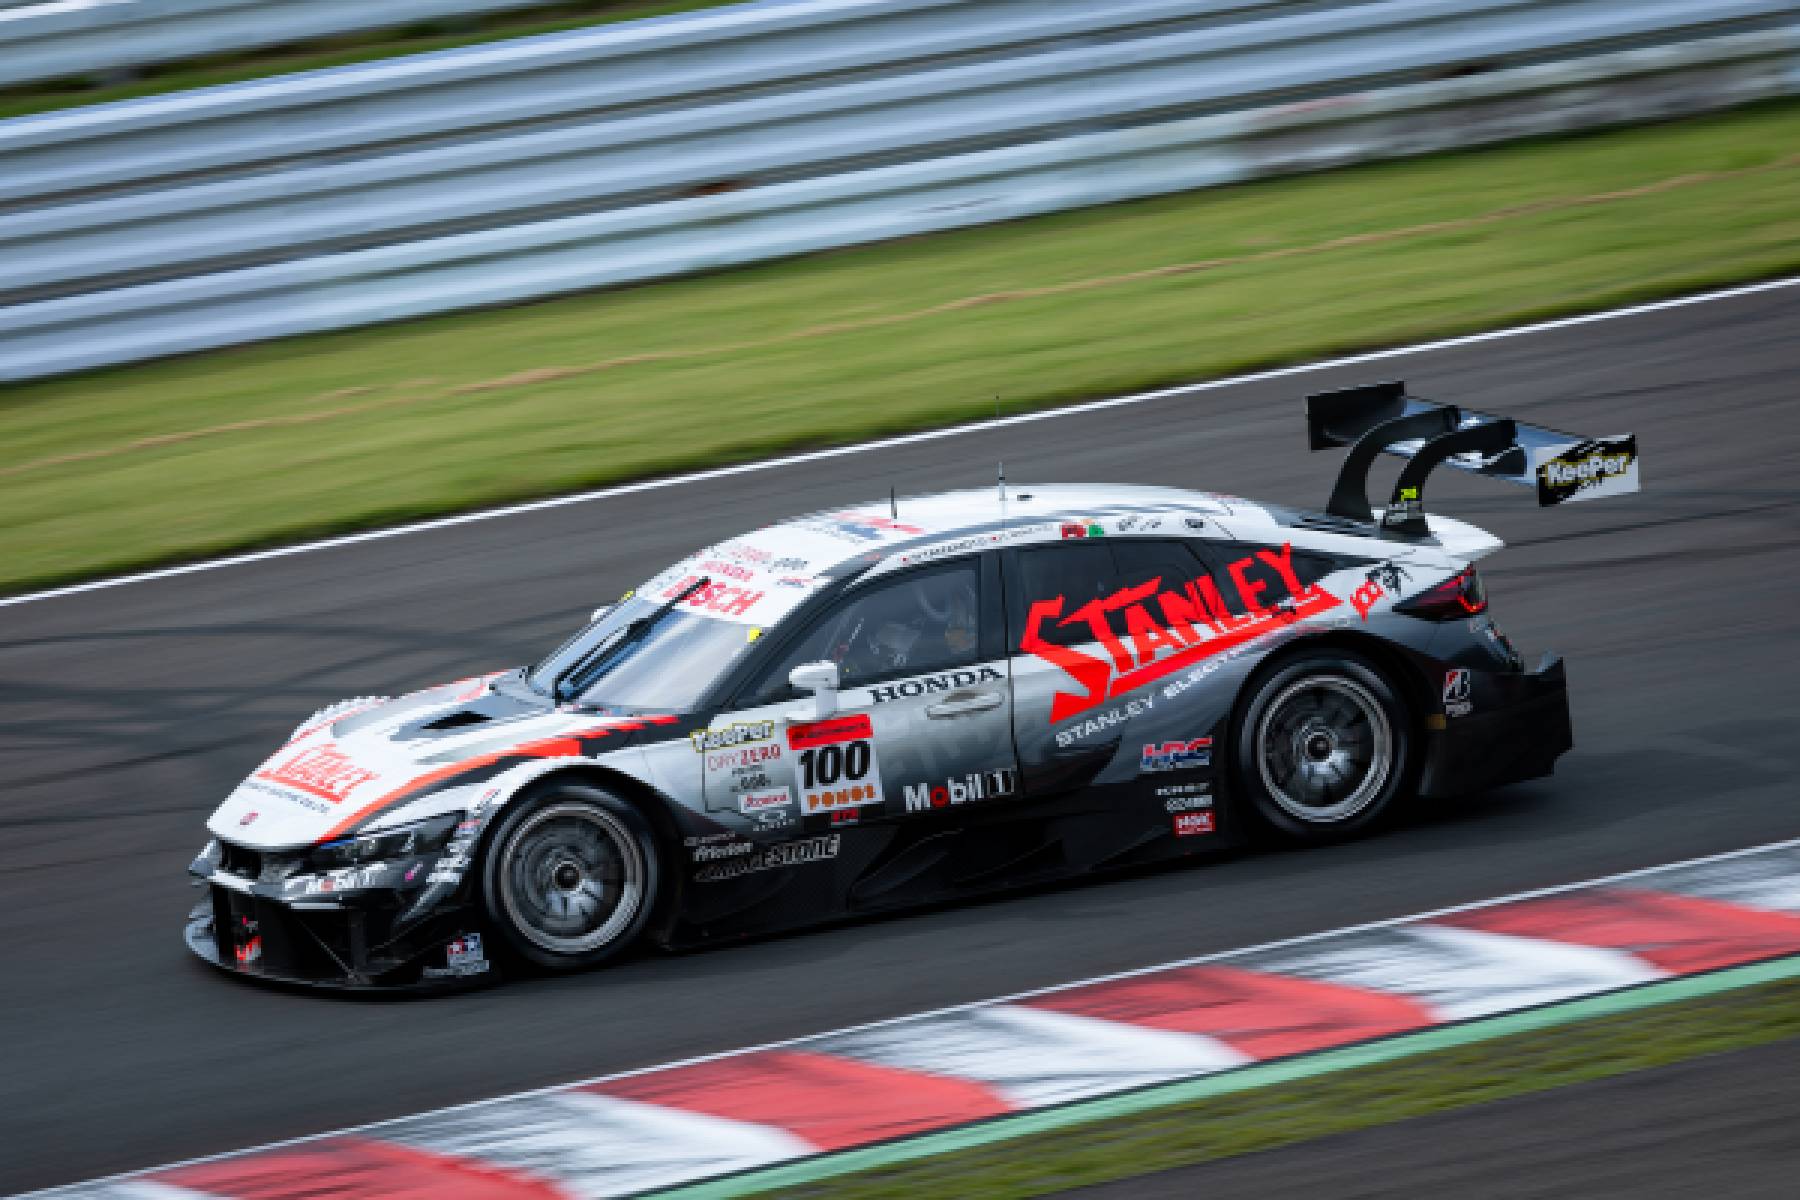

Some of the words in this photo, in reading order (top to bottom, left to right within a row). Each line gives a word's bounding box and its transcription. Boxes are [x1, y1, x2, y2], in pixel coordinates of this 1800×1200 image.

[1545, 453, 1630, 486] KeePer
[1021, 541, 1341, 725] STANLEY
[870, 666, 1005, 704] HONDA
[1055, 694, 1155, 749] STANLEY
[740, 743, 782, 767] ZERO
[799, 740, 871, 790] 100
[807, 783, 877, 811] PONOS
[903, 773, 985, 813] Mobil
